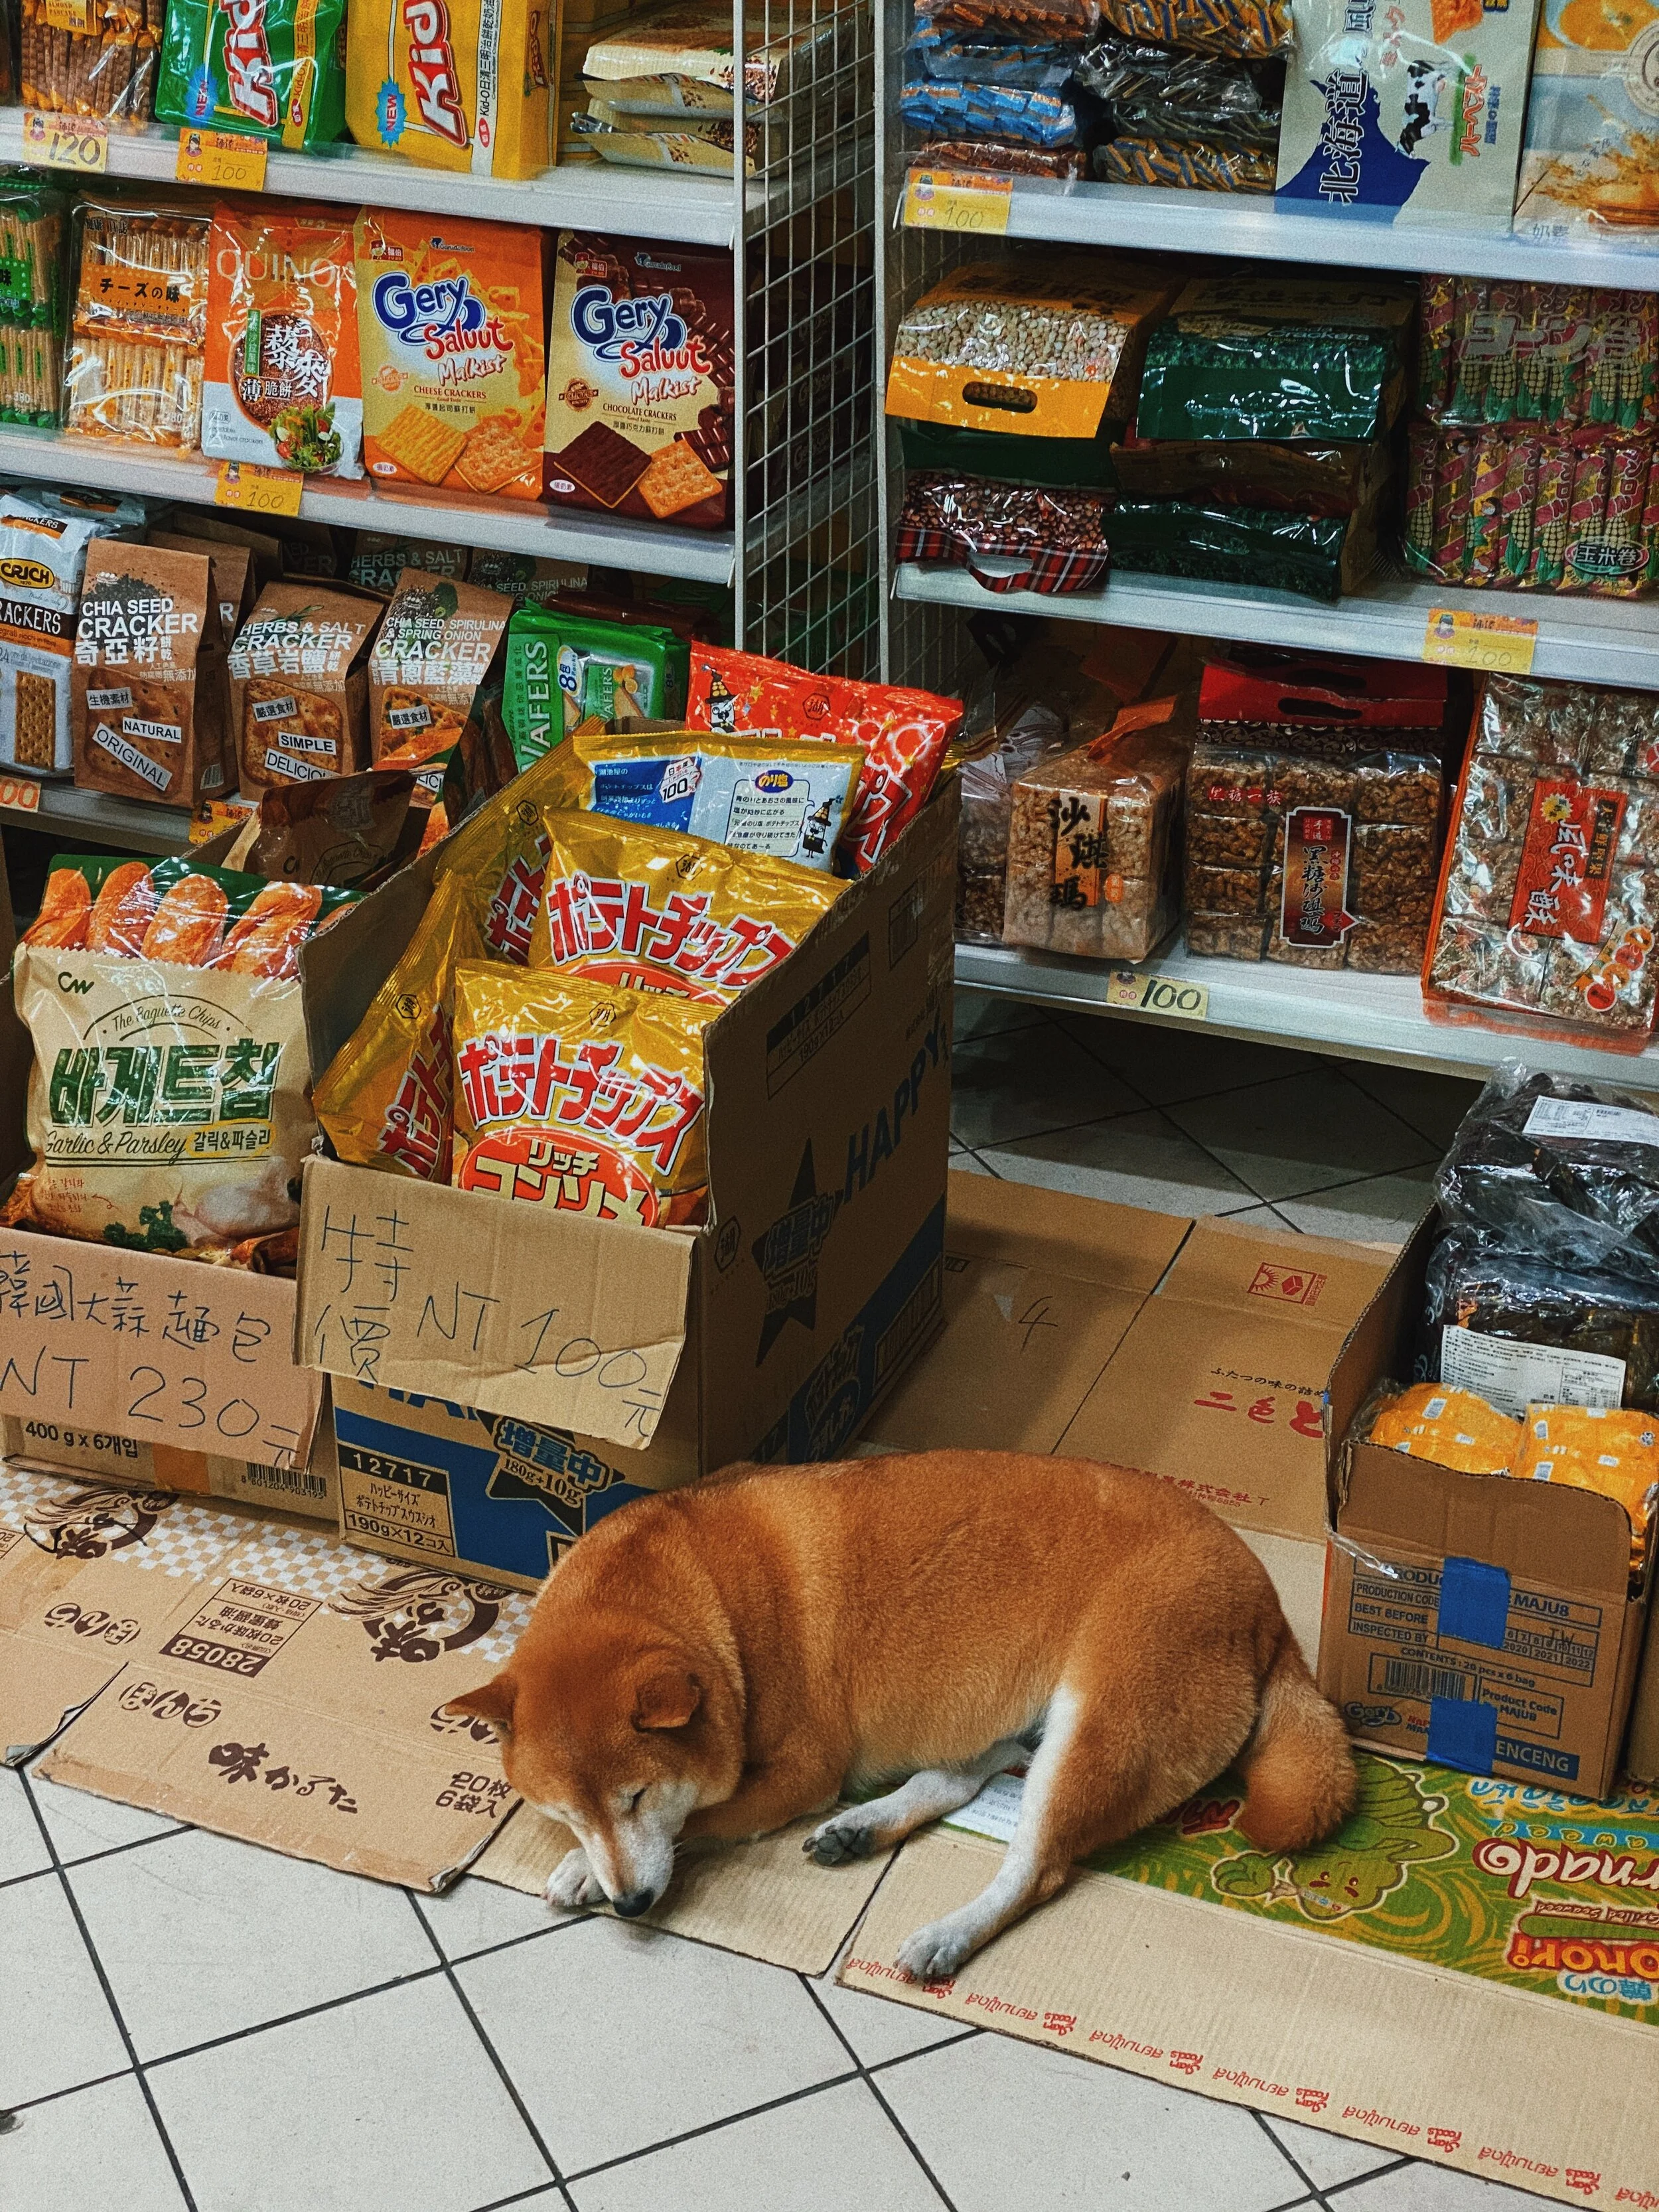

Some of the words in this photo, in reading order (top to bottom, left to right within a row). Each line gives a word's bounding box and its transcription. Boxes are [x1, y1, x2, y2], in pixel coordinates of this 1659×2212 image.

[403, 0, 466, 145] Kid
[386, 94, 397, 131] NEW
[1459, 64, 1486, 157] ハーベスト
[49, 133, 100, 165] 120
[1319, 68, 1368, 203] 北海道
[212, 165, 247, 181] 100
[216, 248, 356, 288] QUINOA
[100, 277, 181, 303] チーズの味
[372, 271, 486, 335] Gery
[571, 284, 688, 350] Gery
[423, 316, 514, 360] Saluut
[437, 354, 508, 387] Malkist
[619, 337, 713, 379] Saluut
[414, 386, 443, 396] CHEESE
[444, 388, 486, 399] CRACKERS
[631, 377, 702, 406] Malkist
[603, 404, 642, 416] CHOCOLATE
[644, 409, 677, 420] CRACKERS
[246, 492, 284, 508] 100
[1, 562, 50, 585] CRICH
[82, 601, 123, 617] CHIA
[127, 598, 173, 614] SEED
[78, 613, 198, 638] CRACKER
[240, 621, 299, 636] HERBS
[301, 622, 313, 632] &
[319, 621, 366, 635] SALT
[386, 617, 413, 628] CHIA
[450, 619, 506, 630] SPIRULINA
[398, 629, 441, 640] SPRING
[444, 631, 481, 641] ONION
[74, 636, 159, 666] 奇亞籽
[231, 634, 352, 653] CRACKER
[375, 638, 491, 662] CRACKER
[89, 692, 130, 706] 生機素材
[124, 720, 180, 740] NATURAL
[281, 735, 334, 752] SIMPLE
[97, 729, 165, 788] ORIGINAL
[758, 773, 788, 788] のり塩
[1140, 980, 1202, 1011] 100
[112, 1011, 134, 1030] The
[189, 1004, 221, 1030] Chips
[50, 1037, 284, 1128] 바게트칩
[458, 1033, 705, 1176] ポテトチップス
[45, 1131, 95, 1155] Garlic
[97, 1134, 116, 1154] &
[118, 1133, 186, 1165] Parsley
[528, 1137, 599, 1175] リッチ
[417, 1281, 500, 1351] NT
[1, 1346, 90, 1409] NT
[25, 1421, 59, 1441] 400
[93, 1434, 139, 1458] 6개입
[500, 1420, 605, 1485] 増量中
[352, 1452, 433, 1488] 12717
[370, 1482, 421, 1506] ハッピーサイズ
[1356, 1582, 1413, 1603] PRODUCTION
[1415, 1591, 1440, 1607] CODE
[1514, 1595, 1569, 1617] MAJU8
[1354, 1603, 1382, 1618] BEST
[1385, 1609, 1429, 1625] BEFORE
[1352, 1621, 1413, 1641] INSPECTED
[1415, 1632, 1429, 1643] BY
[171, 1638, 262, 1673] 28058
[1401, 1647, 1457, 1667] CONTENTS
[1479, 1666, 1496, 1678] pcs
[1515, 1674, 1536, 1688] bag
[1504, 1642, 1528, 1654] 2020
[1534, 1649, 1559, 1661] 2021
[1565, 1657, 1591, 1669] 2022
[1482, 1688, 1527, 1708] Product
[1529, 1696, 1557, 1715] Code
[208, 1741, 360, 1815] 味かるた
[435, 1790, 498, 1819] 6袋入
